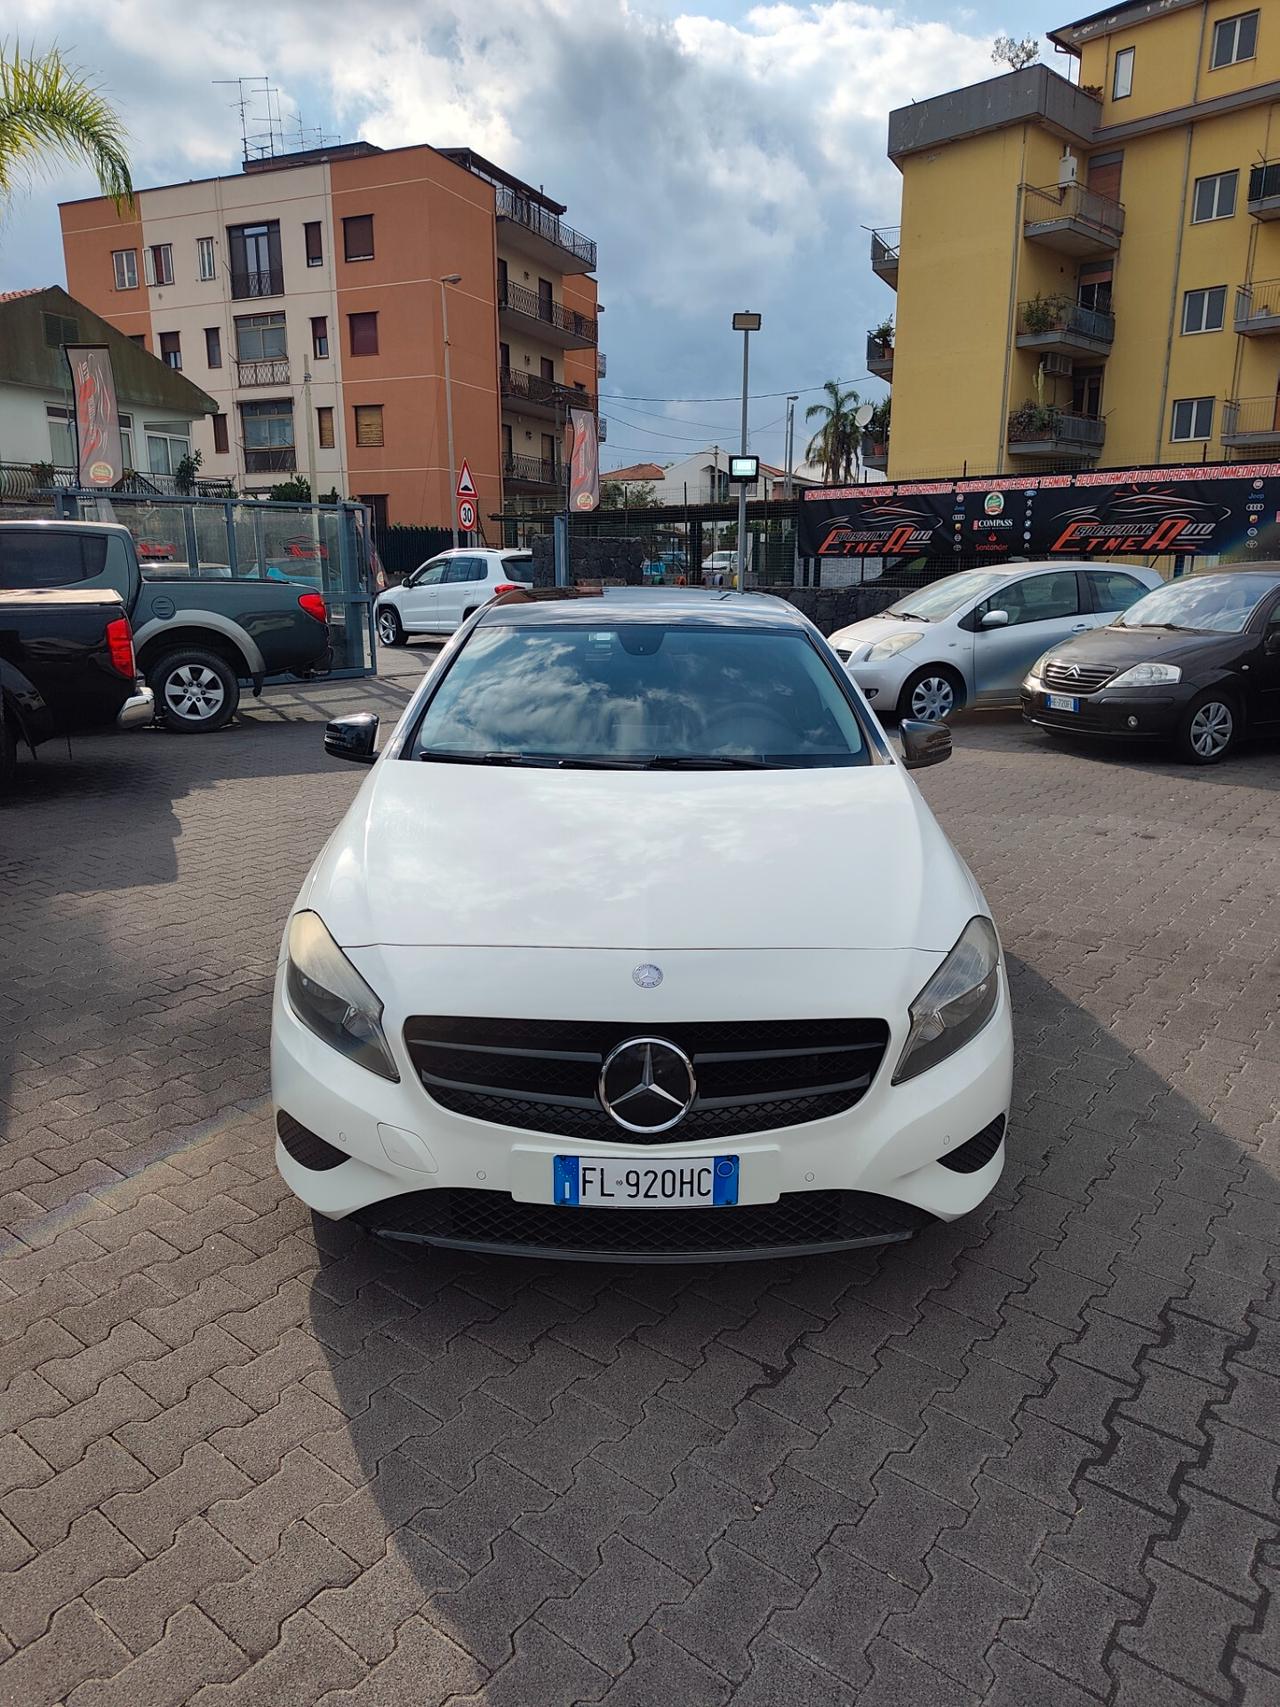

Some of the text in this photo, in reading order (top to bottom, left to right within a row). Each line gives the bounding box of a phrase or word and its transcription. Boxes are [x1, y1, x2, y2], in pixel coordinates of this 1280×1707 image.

[1039, 475, 1072, 488] TERMINE
[1074, 471, 1126, 487] ACQUISTIAMO
[1125, 470, 1149, 483] AUTO
[1148, 469, 1167, 482] CON
[1166, 466, 1220, 481] PAGAMENTO
[1219, 464, 1271, 479] IMMEDIATO
[462, 507, 472, 523] 30
[978, 519, 1014, 528] COMPASS
[975, 543, 1009, 551] Santander
